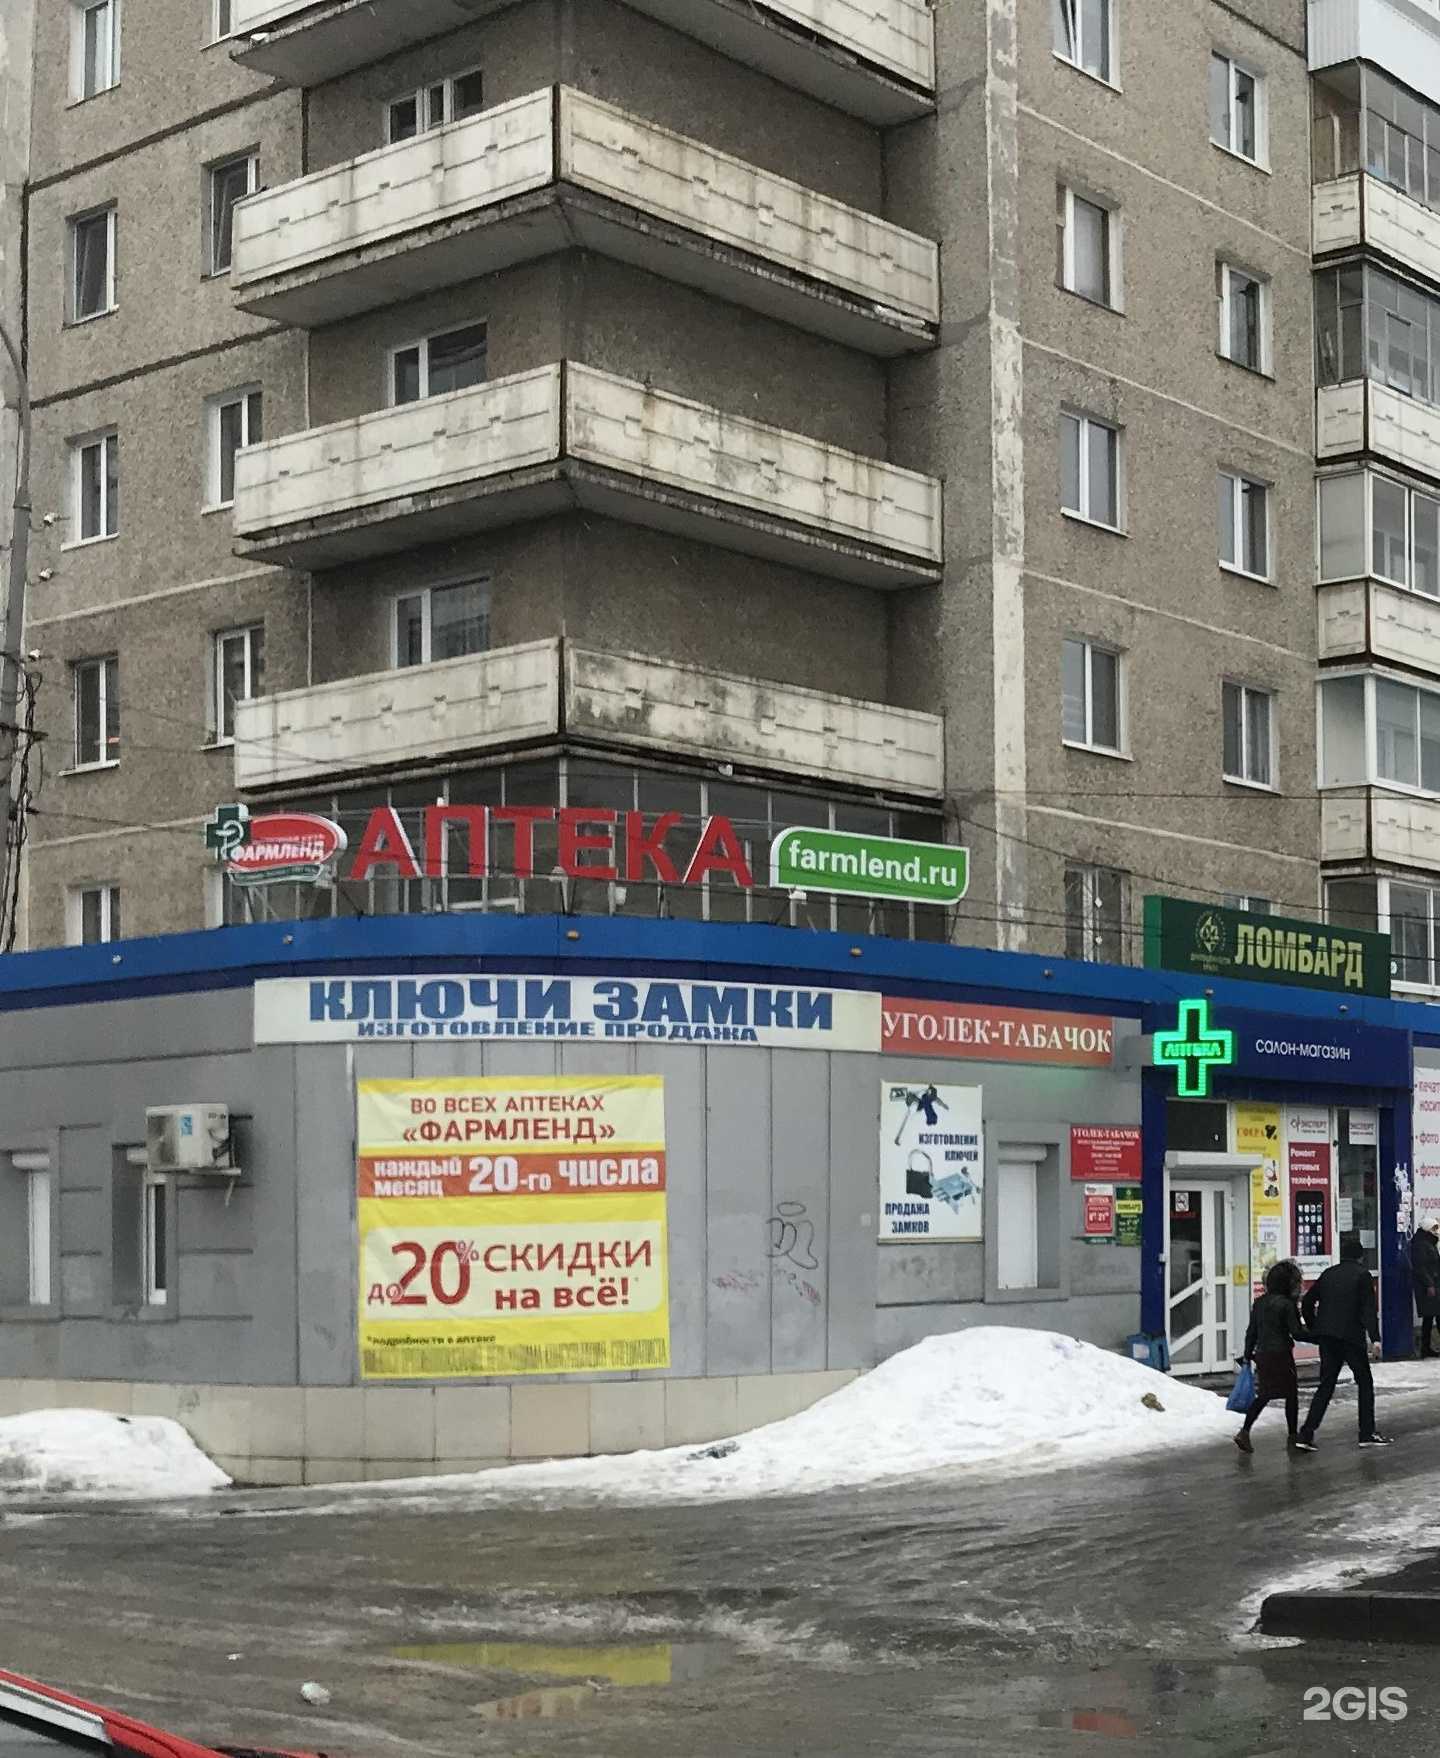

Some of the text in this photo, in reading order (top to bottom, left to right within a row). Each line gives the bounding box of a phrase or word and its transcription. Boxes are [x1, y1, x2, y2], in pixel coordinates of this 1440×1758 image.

[230, 841, 325, 861] ФАРМЛЕНД
[345, 805, 753, 887] АПТЕКА
[788, 839, 958, 887] farmlend.ru
[1234, 923, 1363, 988] ЛОМБАРД
[309, 979, 833, 1031] КЛЮЧИ ЗАМКИ
[357, 1020, 759, 1043] ИЗГОТОВЛЕНИЕ ПРОДАЖА
[882, 1011, 1112, 1053] УГОЛЕК-ТАБАЧОК
[1165, 1043, 1221, 1057] АПТЕКА
[1255, 1039, 1351, 1060] салон-магазин
[410, 1095, 605, 1114] ВО ВСЕХ АПТЕКАХ
[403, 1117, 615, 1144] «ФАРМЛЕНД»
[919, 1133, 979, 1146] ИЗГОТОВЛЕНИЕ
[374, 1157, 462, 1178] каждый
[468, 1156, 659, 1193] 20-го числа
[374, 1179, 444, 1199] месяц
[885, 1202, 931, 1216] ПРОДАЖА
[892, 1221, 930, 1234] ЗАМКОВ
[368, 1283, 401, 1305] до
[495, 1277, 630, 1310] на всё!
